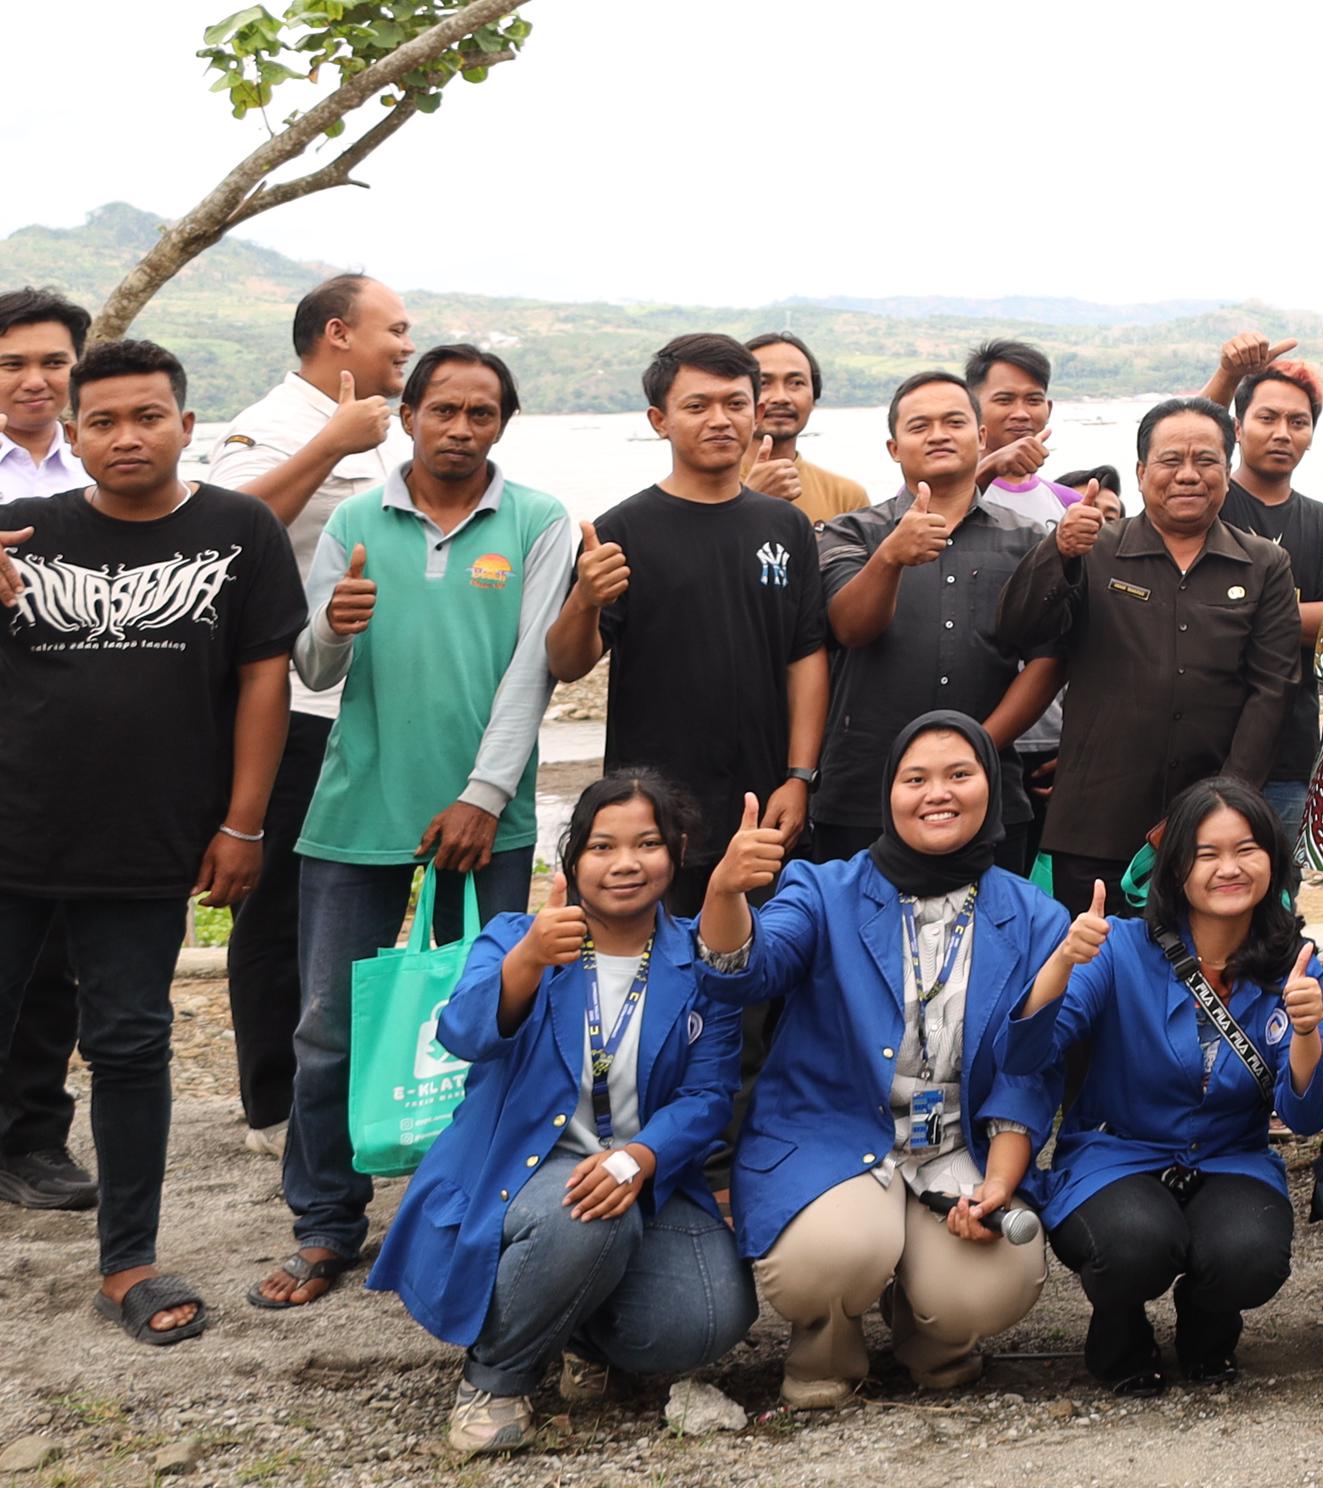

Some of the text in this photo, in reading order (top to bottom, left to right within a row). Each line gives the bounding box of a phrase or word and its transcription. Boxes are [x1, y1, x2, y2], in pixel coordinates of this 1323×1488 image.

[756, 541, 791, 587] NY
[1194, 982, 1265, 1077] FILA FILA FILA FILA
[393, 1073, 465, 1102] E-KLAT
